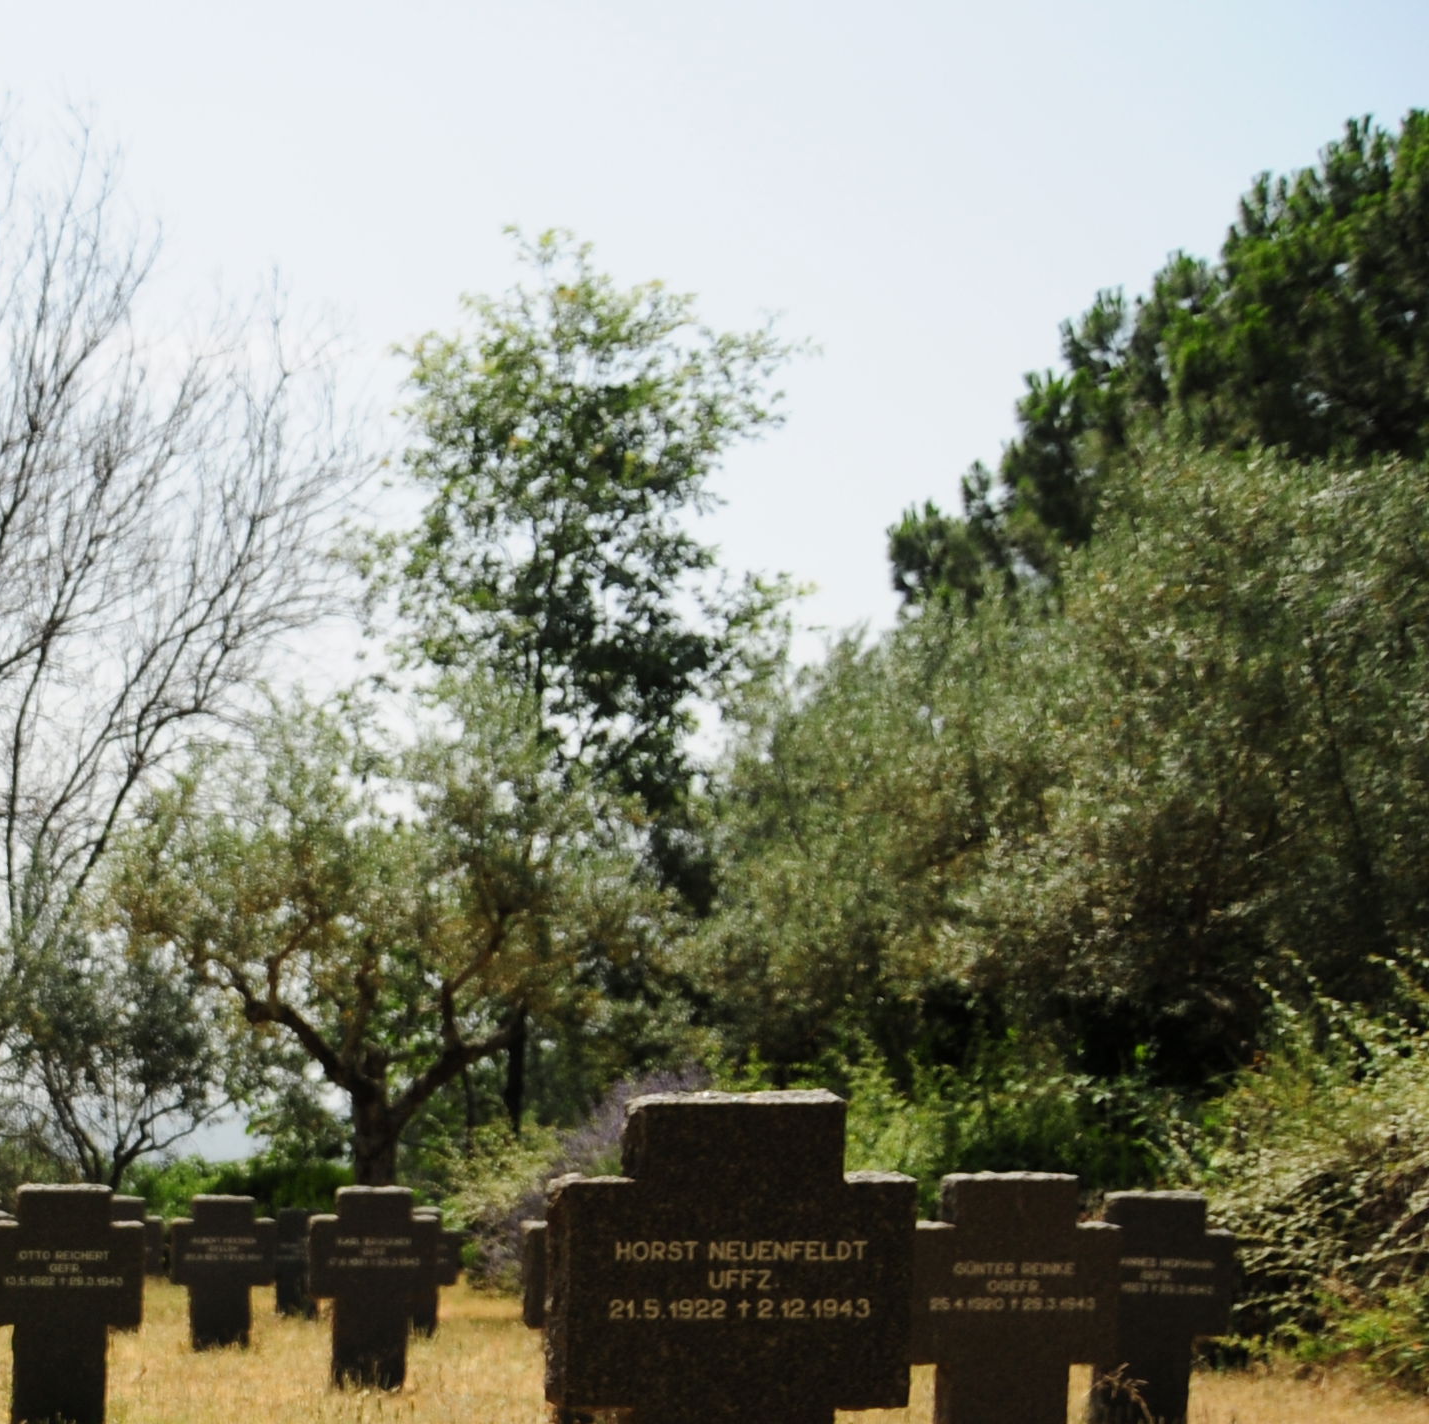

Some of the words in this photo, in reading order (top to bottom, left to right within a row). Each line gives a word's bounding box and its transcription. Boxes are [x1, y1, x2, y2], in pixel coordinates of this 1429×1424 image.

[19, 1250, 51, 1261] OTTO
[55, 1250, 110, 1261] REICHERT
[615, 1241, 699, 1261] HORST
[708, 1240, 869, 1261] NEUENFELDT
[49, 1263, 82, 1273] GEFR.
[953, 1261, 1015, 1275] GÜNTER
[708, 1269, 781, 1290] UFFZ.
[609, 1298, 727, 1319] 21.5.1922
[757, 1298, 871, 1319] 2.12.1943
